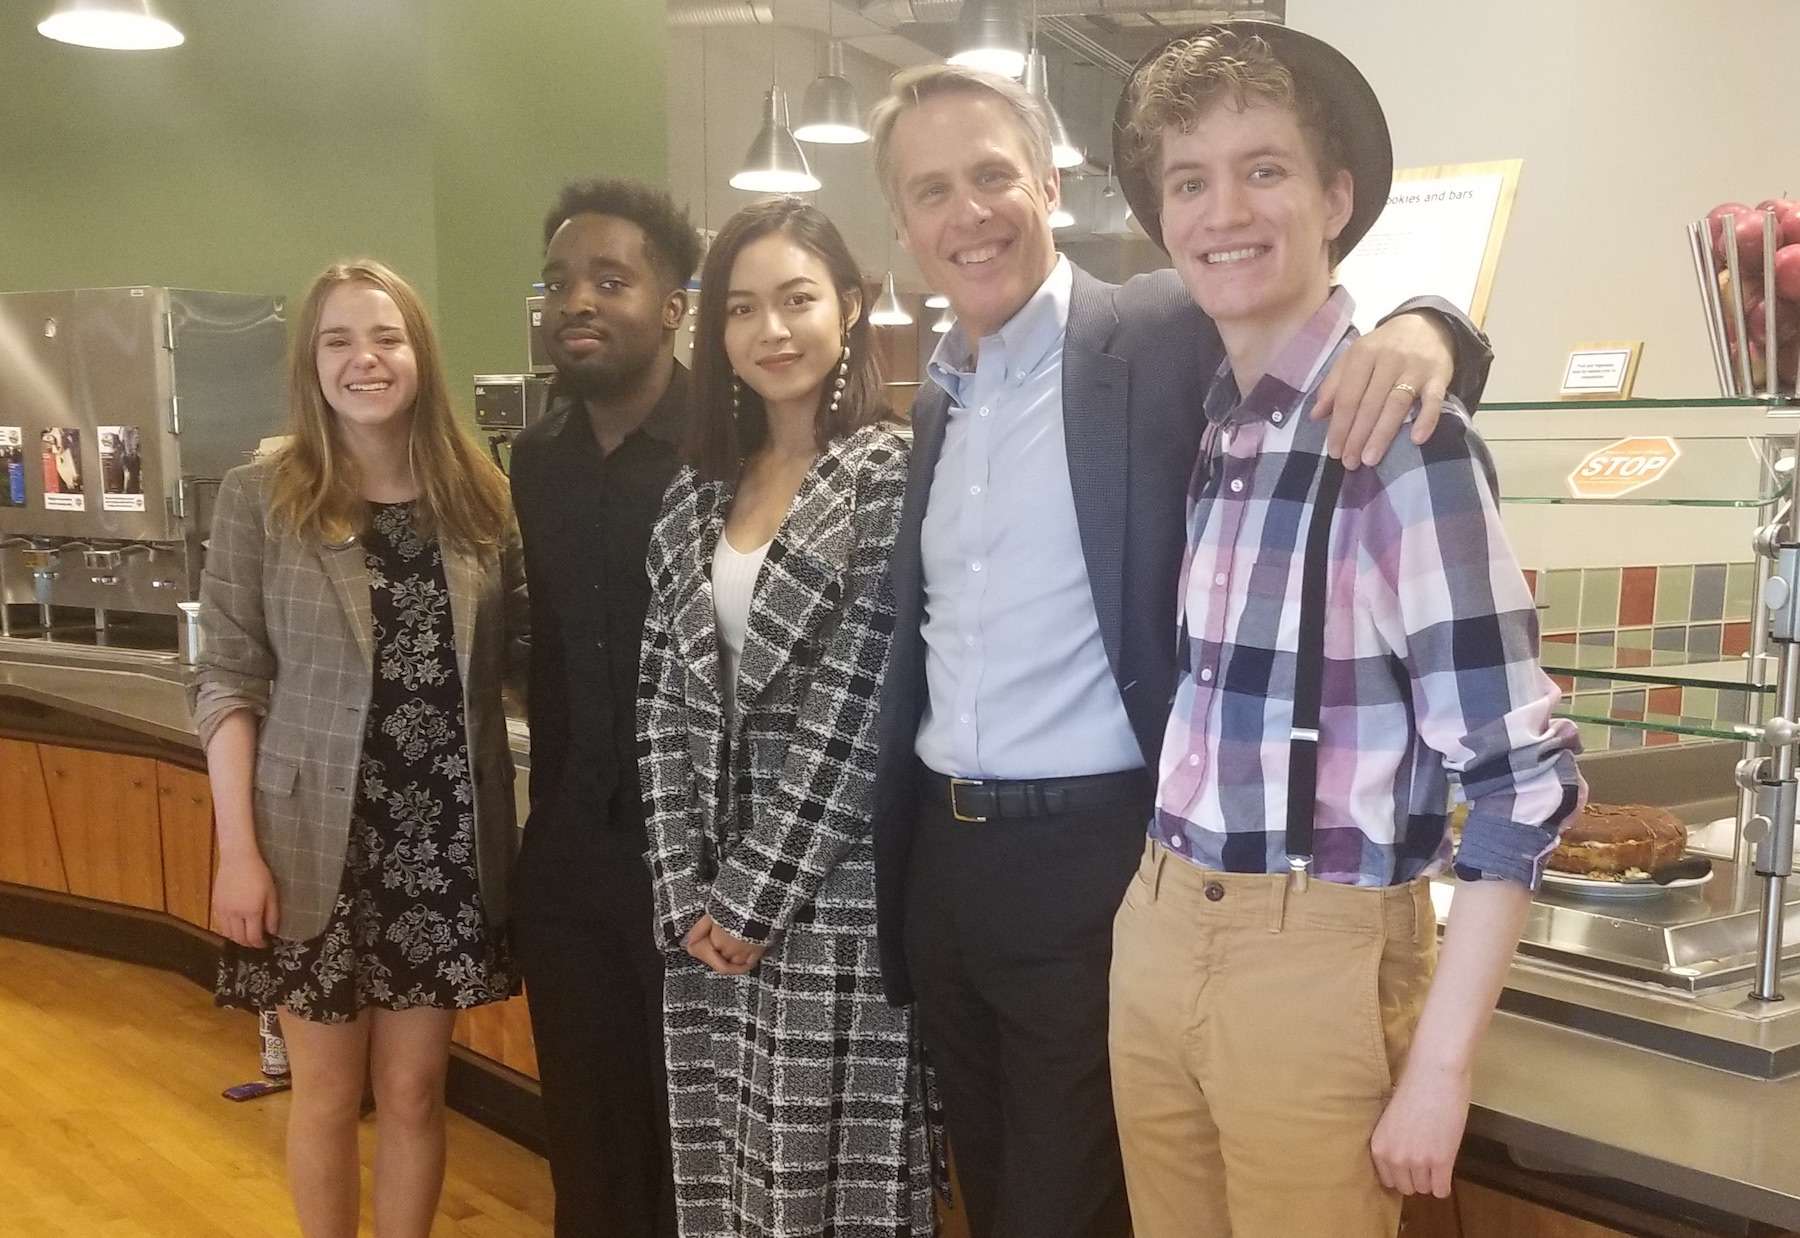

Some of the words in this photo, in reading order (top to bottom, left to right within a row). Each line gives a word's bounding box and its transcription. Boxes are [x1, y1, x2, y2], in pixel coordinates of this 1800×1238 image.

[1386, 194, 1420, 205] ookies
[1424, 191, 1445, 202] and
[1449, 190, 1473, 200] bars
[1581, 455, 1667, 477] STOP
